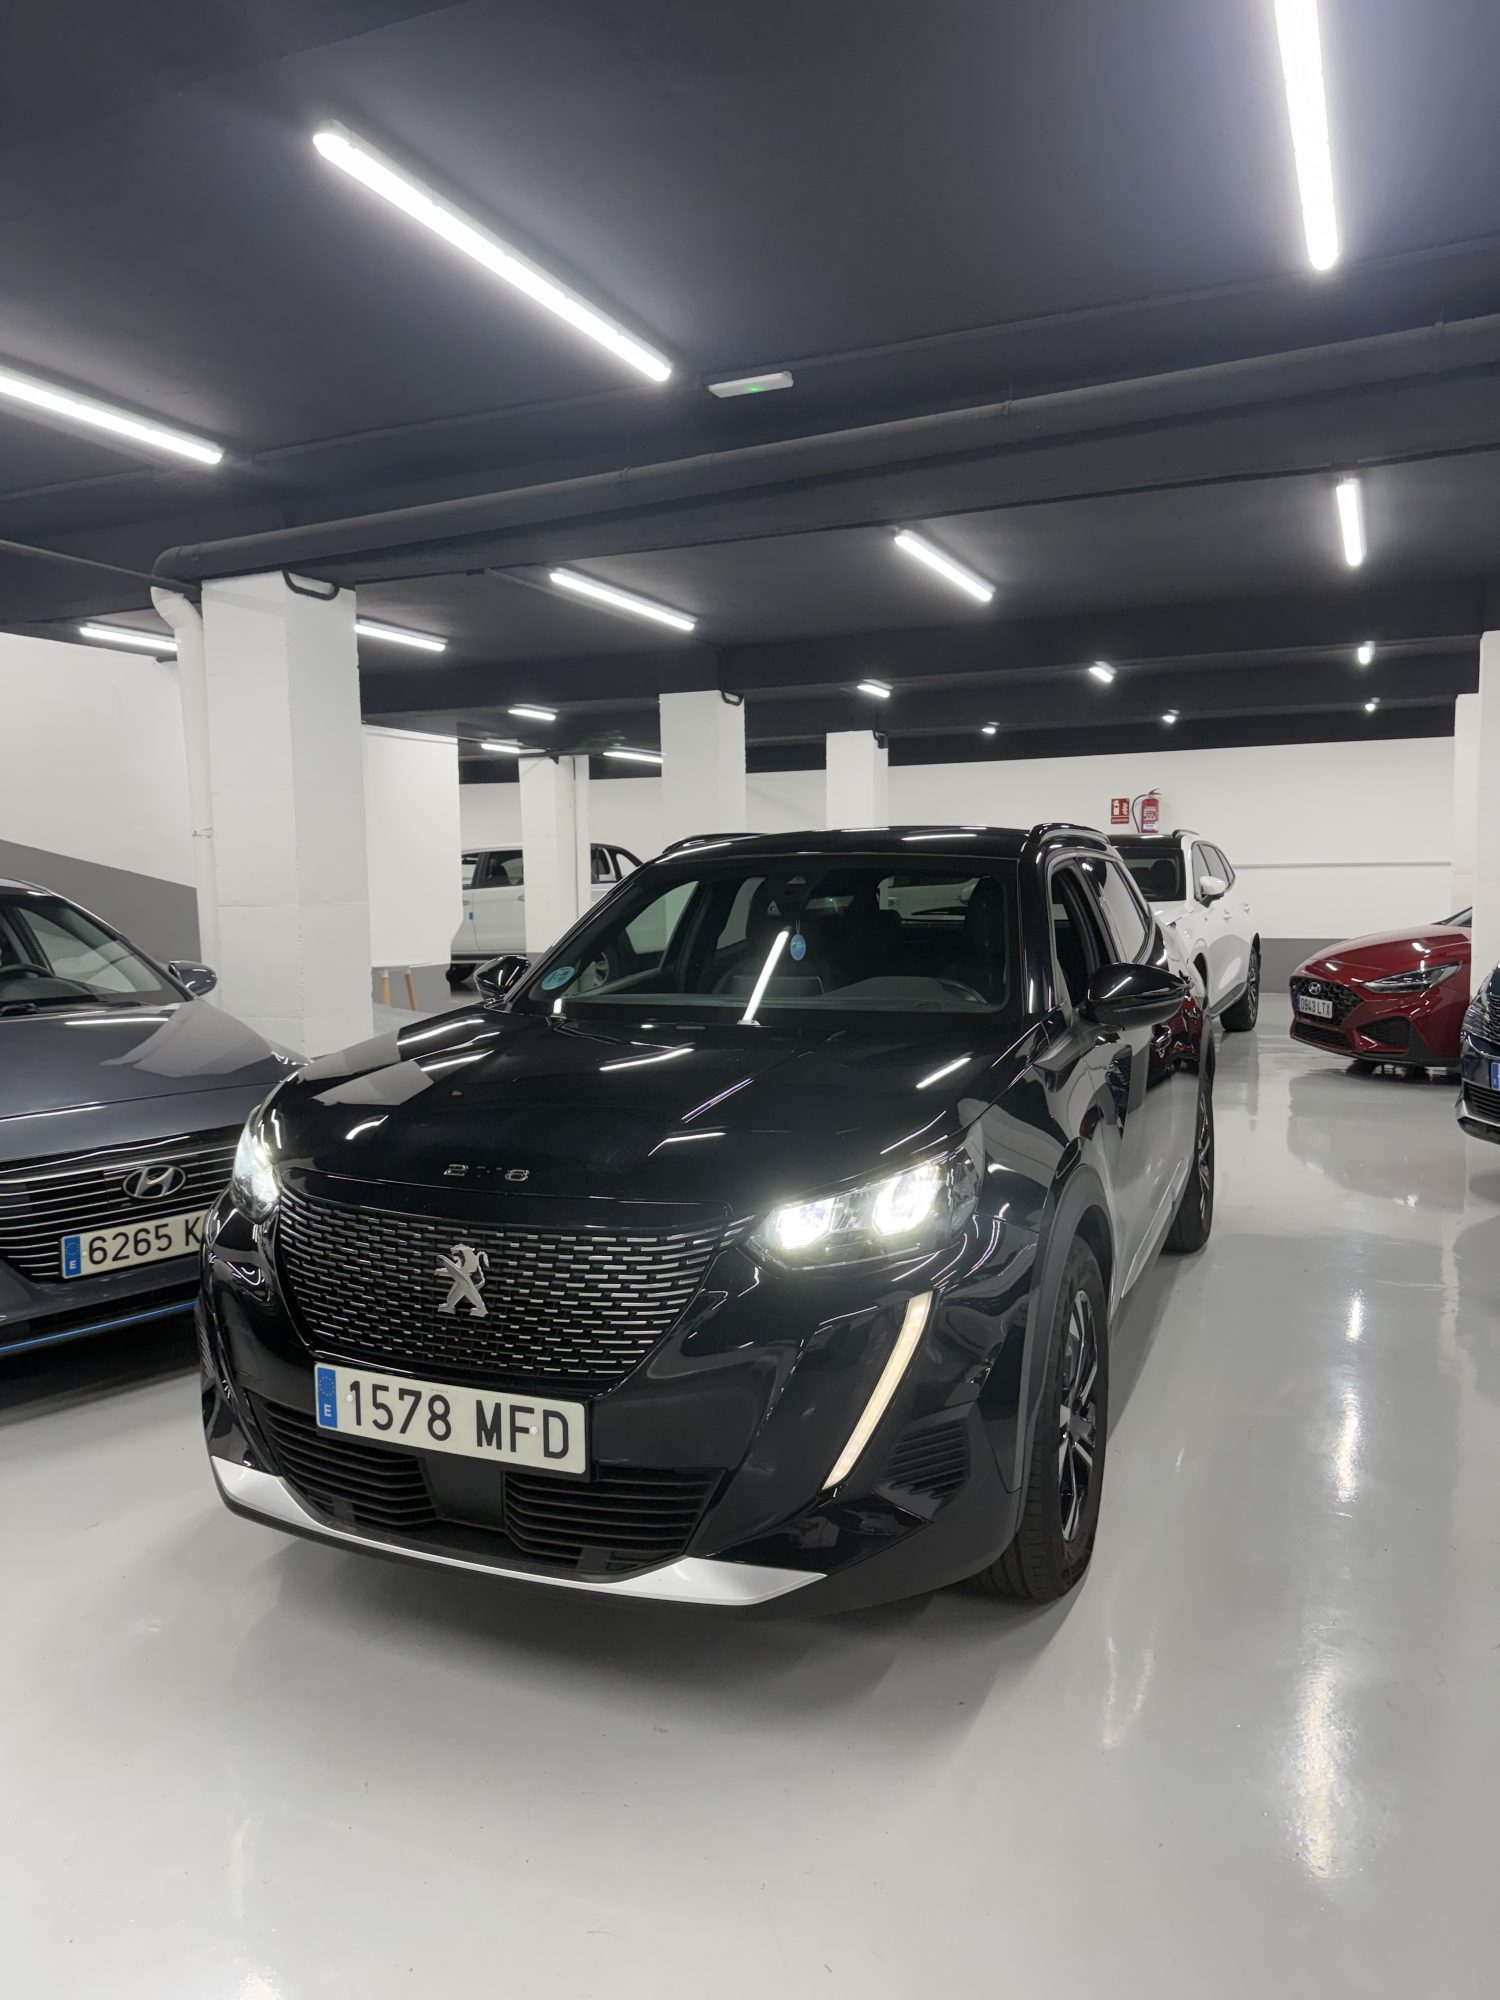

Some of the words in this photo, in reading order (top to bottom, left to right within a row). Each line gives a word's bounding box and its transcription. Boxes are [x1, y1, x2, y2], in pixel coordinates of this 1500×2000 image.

[69, 1259, 77, 1270] E
[88, 1223, 172, 1265] 6265
[324, 1403, 332, 1418] E
[350, 1380, 452, 1442] 1578
[475, 1399, 569, 1460] MFD
